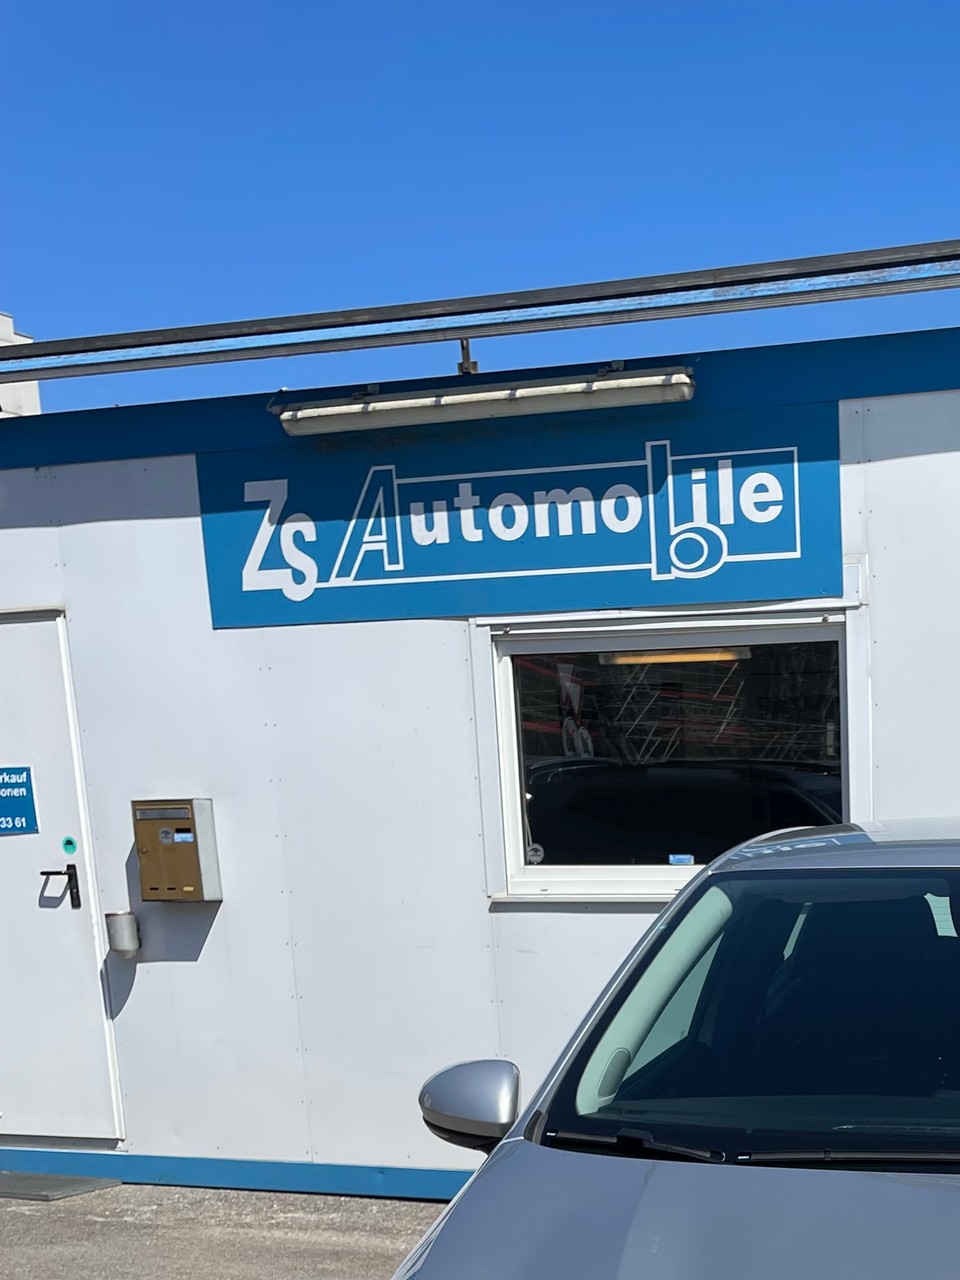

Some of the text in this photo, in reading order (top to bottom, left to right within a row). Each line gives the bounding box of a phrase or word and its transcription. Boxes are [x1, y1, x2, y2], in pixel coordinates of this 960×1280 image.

[242, 440, 786, 601] Zs Automobile
[15, 816, 26, 828] 61
